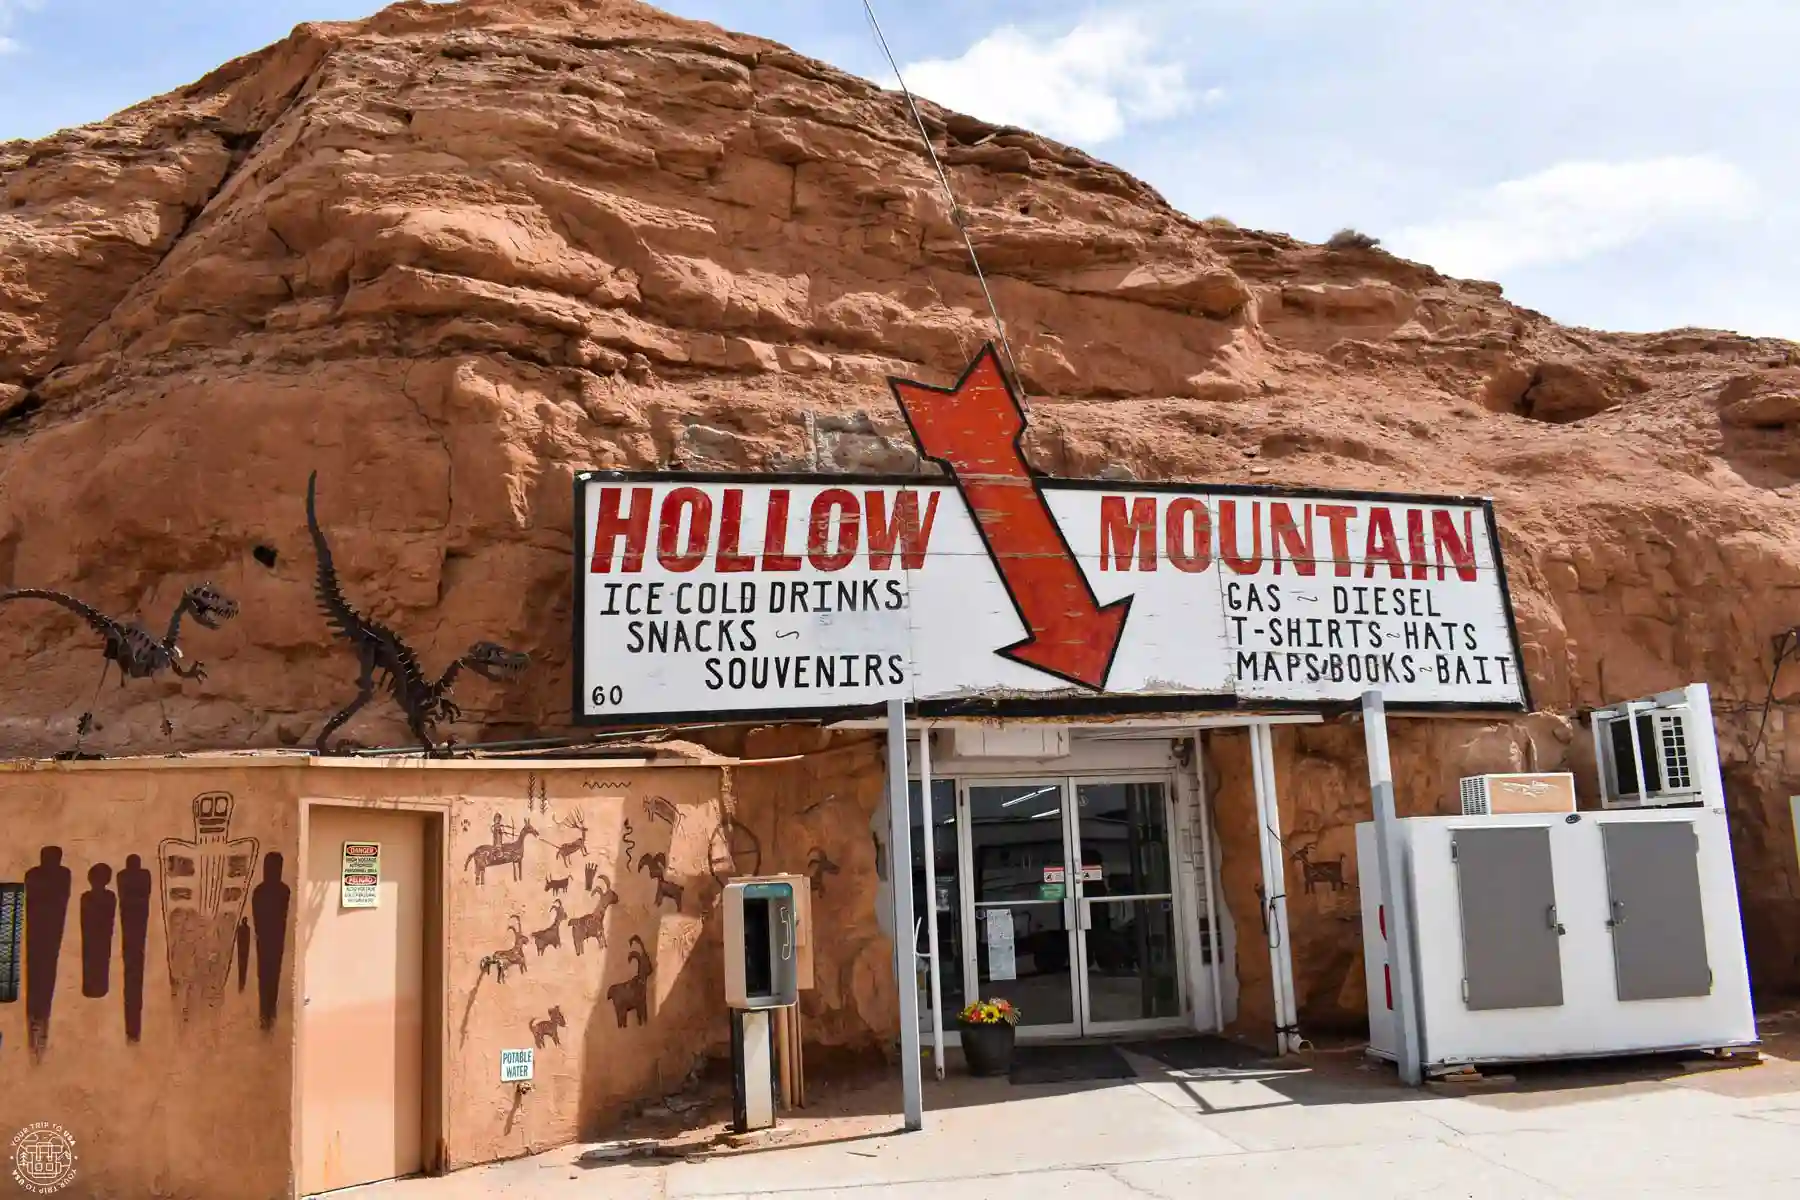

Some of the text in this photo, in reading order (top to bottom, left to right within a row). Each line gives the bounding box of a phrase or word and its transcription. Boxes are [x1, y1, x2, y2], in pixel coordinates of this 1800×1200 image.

[590, 486, 1478, 582] HOLLOW MOUNTAIN
[600, 579, 902, 616] ICE COLD DRINKS
[1227, 582, 1441, 617] GAS DIESEL
[626, 619, 758, 653] SNACKS
[1404, 621, 1477, 651] HATS
[705, 654, 905, 691] SOUVENIRS
[1437, 655, 1512, 685] BAIT
[591, 685, 624, 707] 60
[503, 1050, 532, 1064] POTABLE
[507, 1065, 528, 1078] WATER
